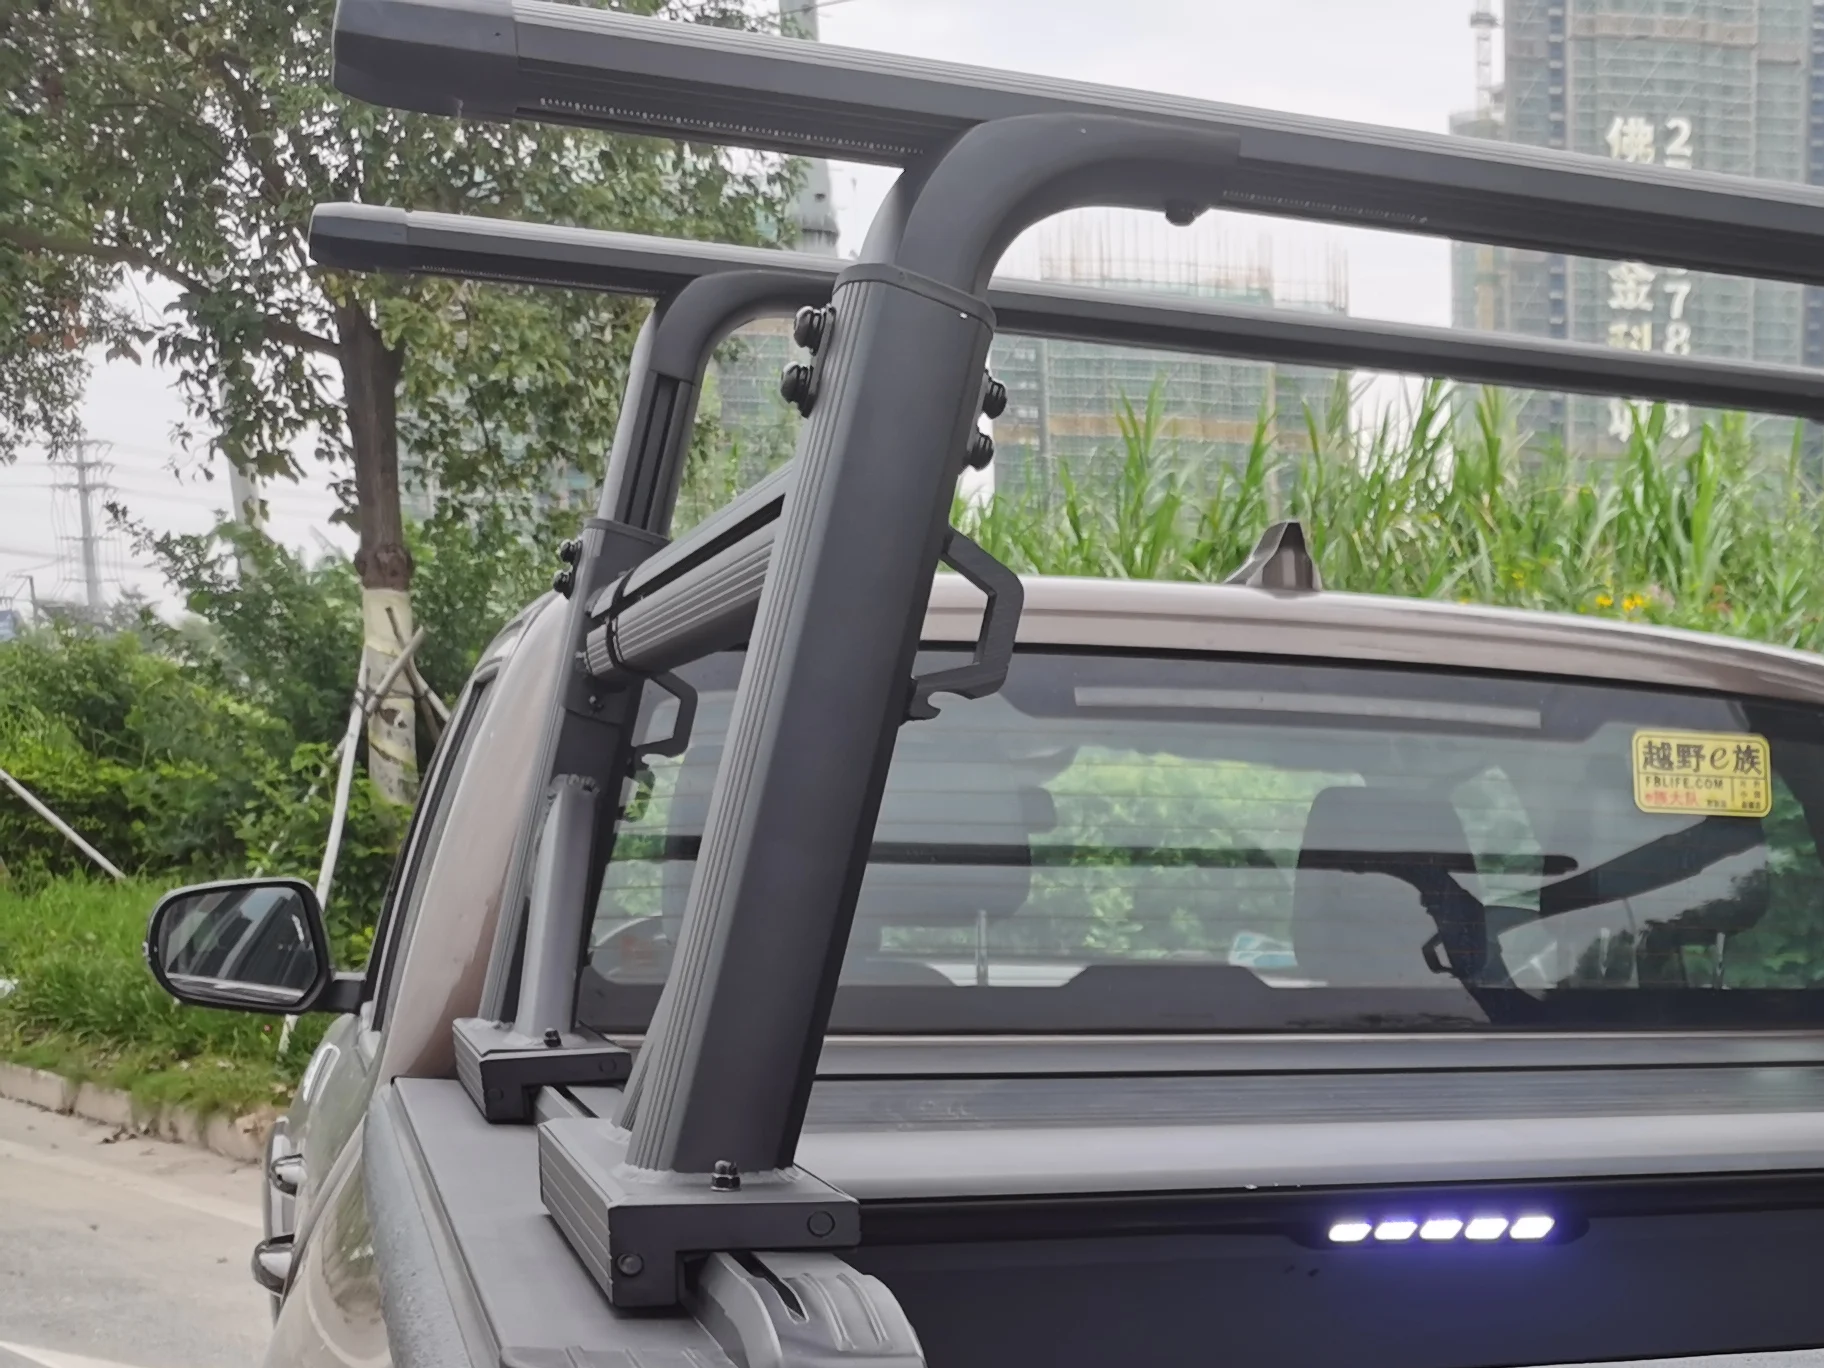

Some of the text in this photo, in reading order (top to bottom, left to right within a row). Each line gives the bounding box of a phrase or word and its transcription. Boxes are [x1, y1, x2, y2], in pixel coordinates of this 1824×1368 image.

[1642, 740, 1762, 775] 越野e族
[1645, 775, 1724, 790] FBLIFE.COM
